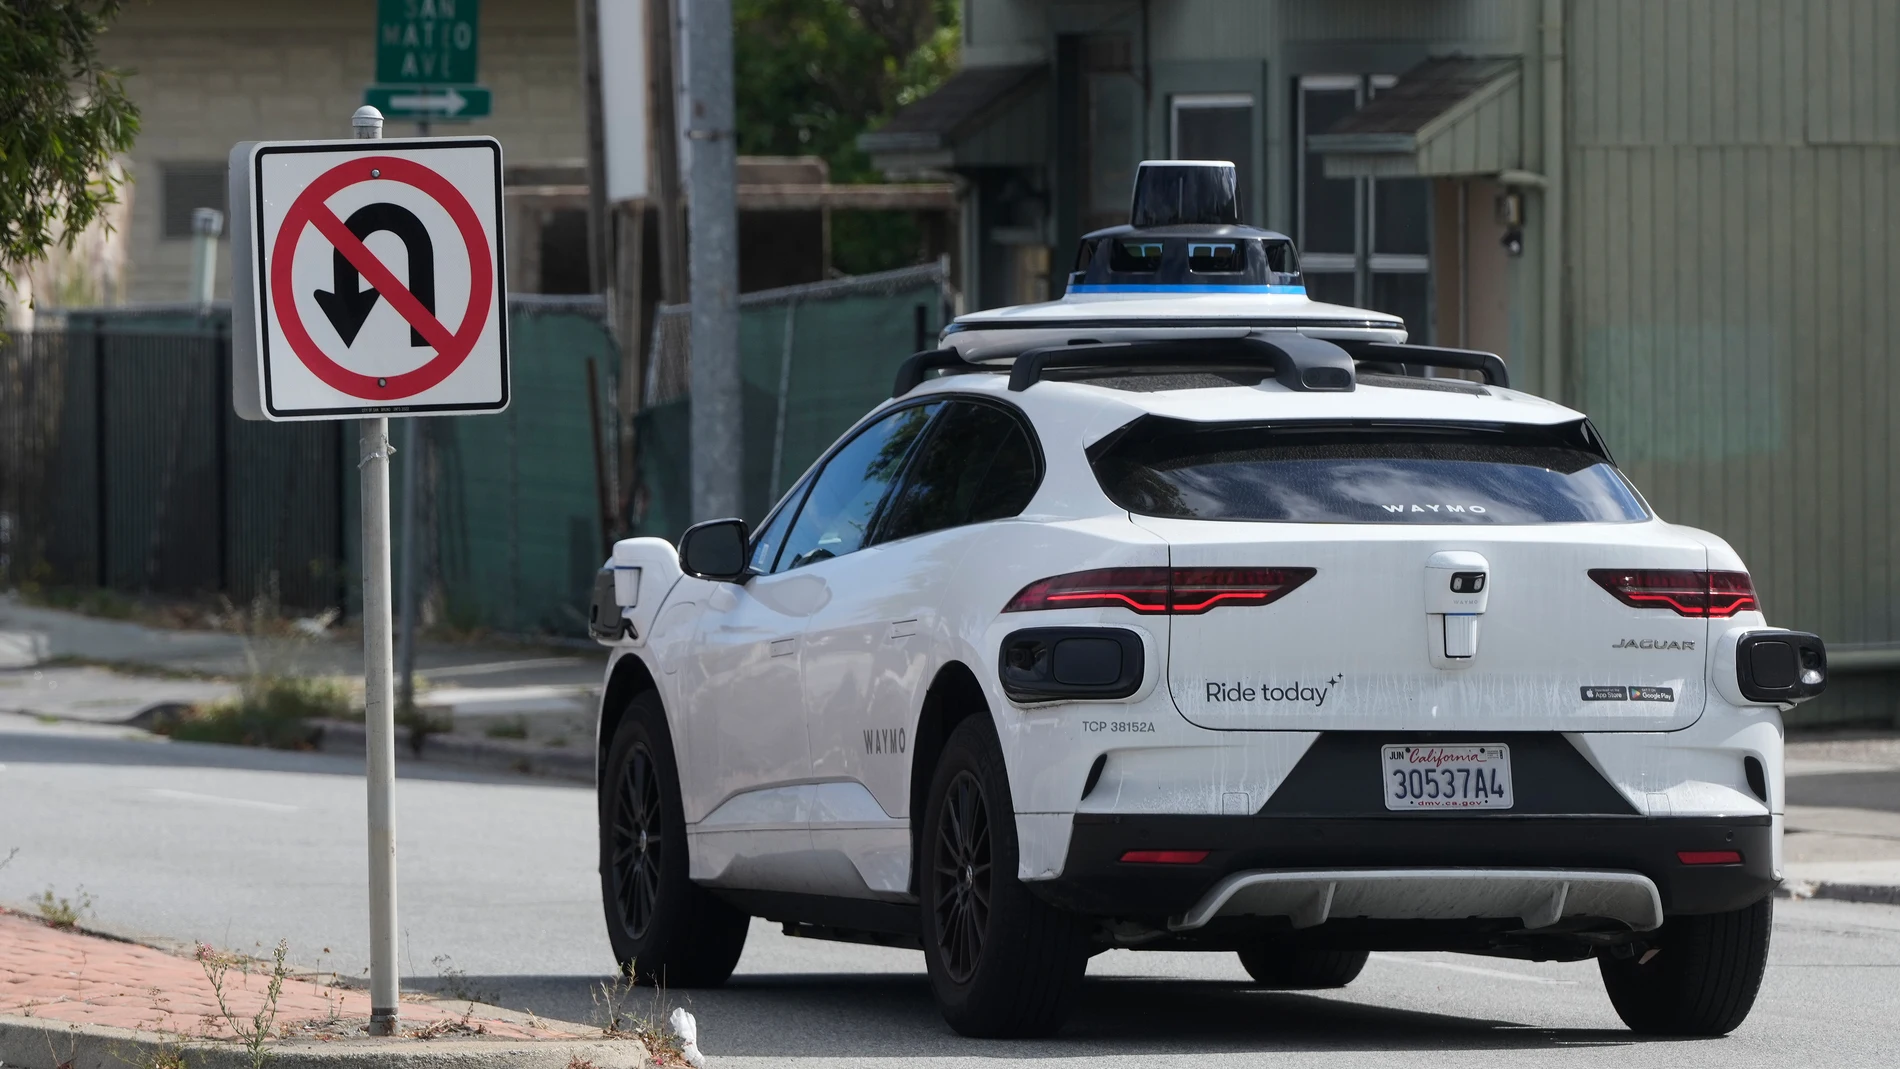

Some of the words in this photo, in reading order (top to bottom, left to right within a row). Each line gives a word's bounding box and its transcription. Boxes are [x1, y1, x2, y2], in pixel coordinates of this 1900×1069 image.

[404, 0, 455, 19] SAN
[382, 22, 472, 50] MATEO
[401, 51, 451, 78] AVE
[1382, 504, 1486, 513] WAYMO
[1612, 639, 1695, 650] JAGUAR
[1206, 682, 1256, 702] Ride
[1261, 681, 1328, 707] today
[1082, 721, 1107, 732] TCP
[1111, 722, 1155, 732] 38152A
[863, 727, 906, 754] WAYMO
[1390, 752, 1404, 760] JUN
[1409, 748, 1487, 767] California
[1393, 768, 1504, 800] 30537A4
